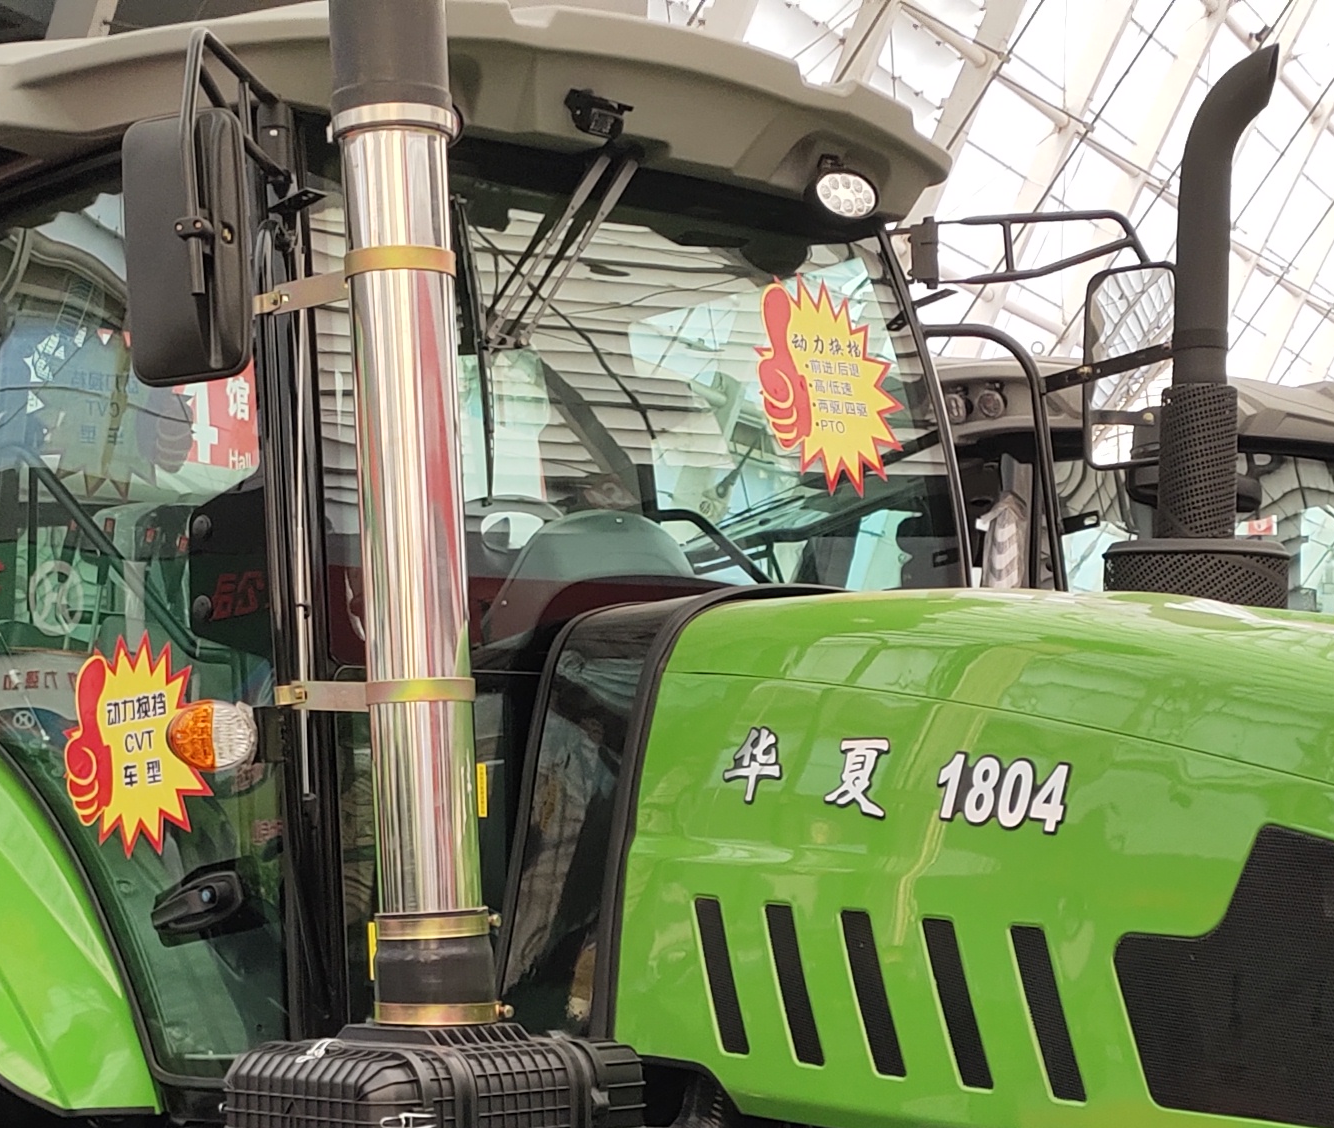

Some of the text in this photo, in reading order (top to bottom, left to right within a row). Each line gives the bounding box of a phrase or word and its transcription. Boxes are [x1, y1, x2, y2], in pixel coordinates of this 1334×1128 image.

[226, 376, 250, 422] 馆
[820, 420, 845, 434] PTO
[229, 448, 252, 470] Hall
[106, 692, 166, 726] 动力换挡
[125, 730, 154, 753] CVT
[124, 759, 162, 787] 车型
[937, 751, 1072, 834] 1804
